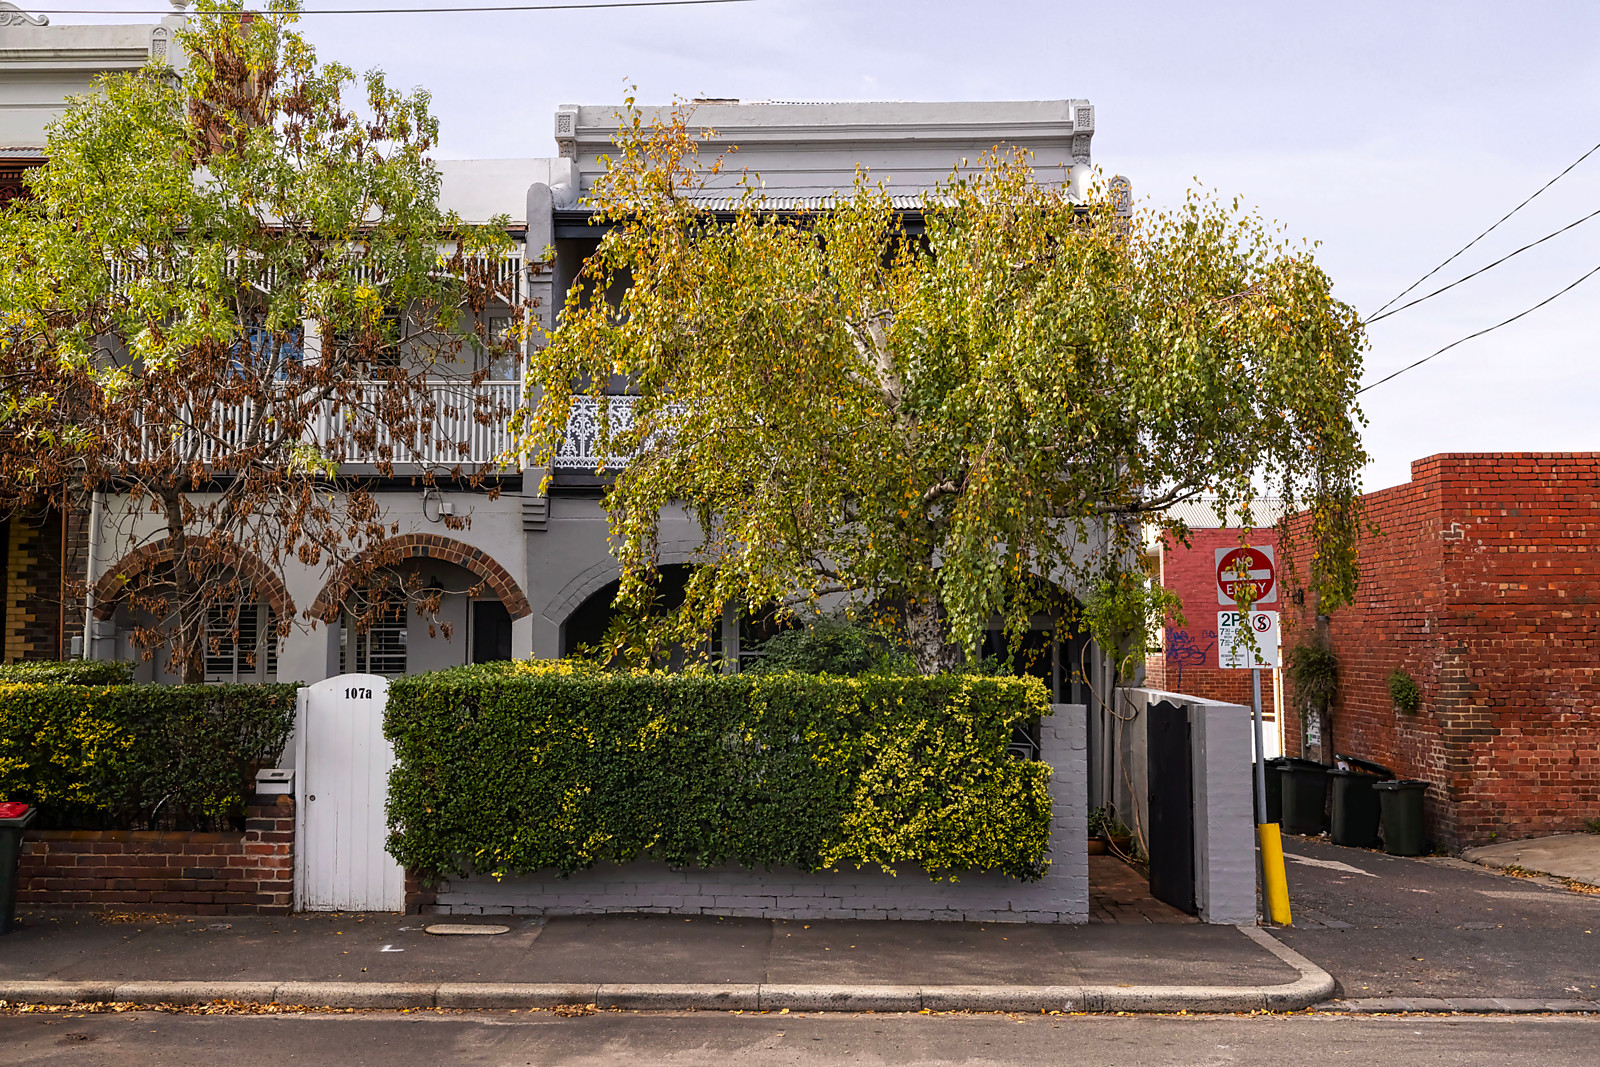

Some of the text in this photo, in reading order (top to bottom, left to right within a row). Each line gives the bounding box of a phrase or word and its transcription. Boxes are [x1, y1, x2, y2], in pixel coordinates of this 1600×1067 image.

[1236, 556, 1253, 567] NO
[1221, 612, 1240, 626] 2P
[345, 687, 372, 699] 107a
